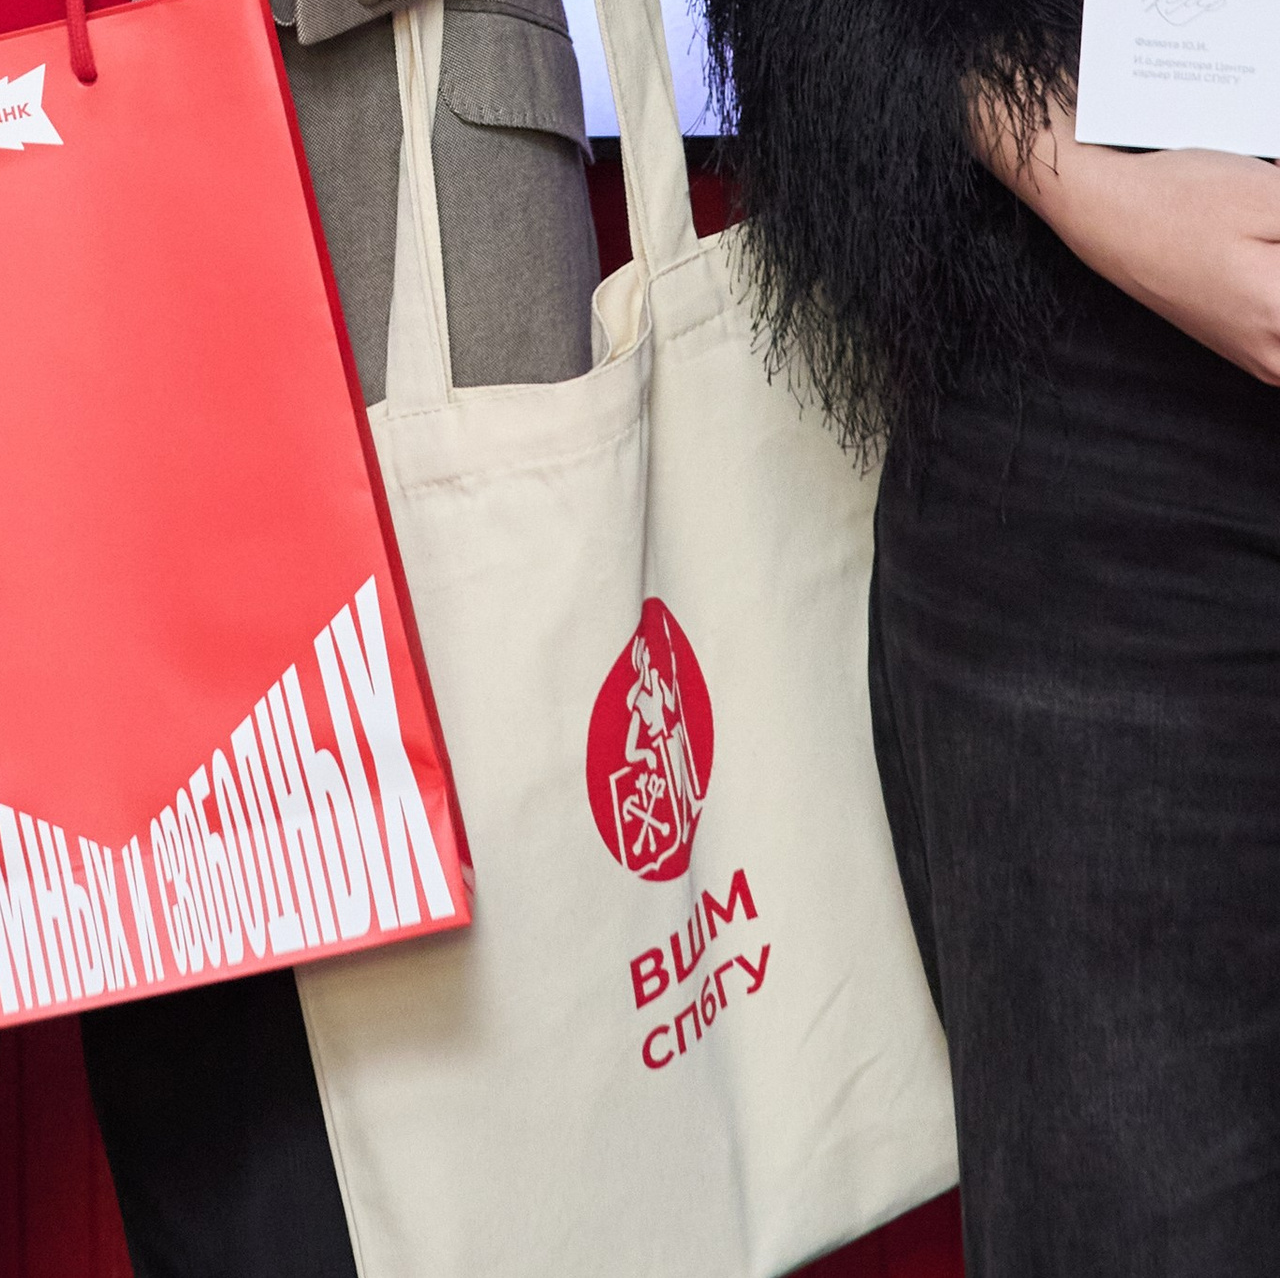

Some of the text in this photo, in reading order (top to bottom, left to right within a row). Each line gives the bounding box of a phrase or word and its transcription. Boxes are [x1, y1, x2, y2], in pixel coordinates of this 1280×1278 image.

[122, 834, 167, 984] И
[149, 574, 456, 976] СВОБОДНЫХ
[629, 868, 759, 1010] ВШМ
[642, 943, 771, 1069] СПбГУ
